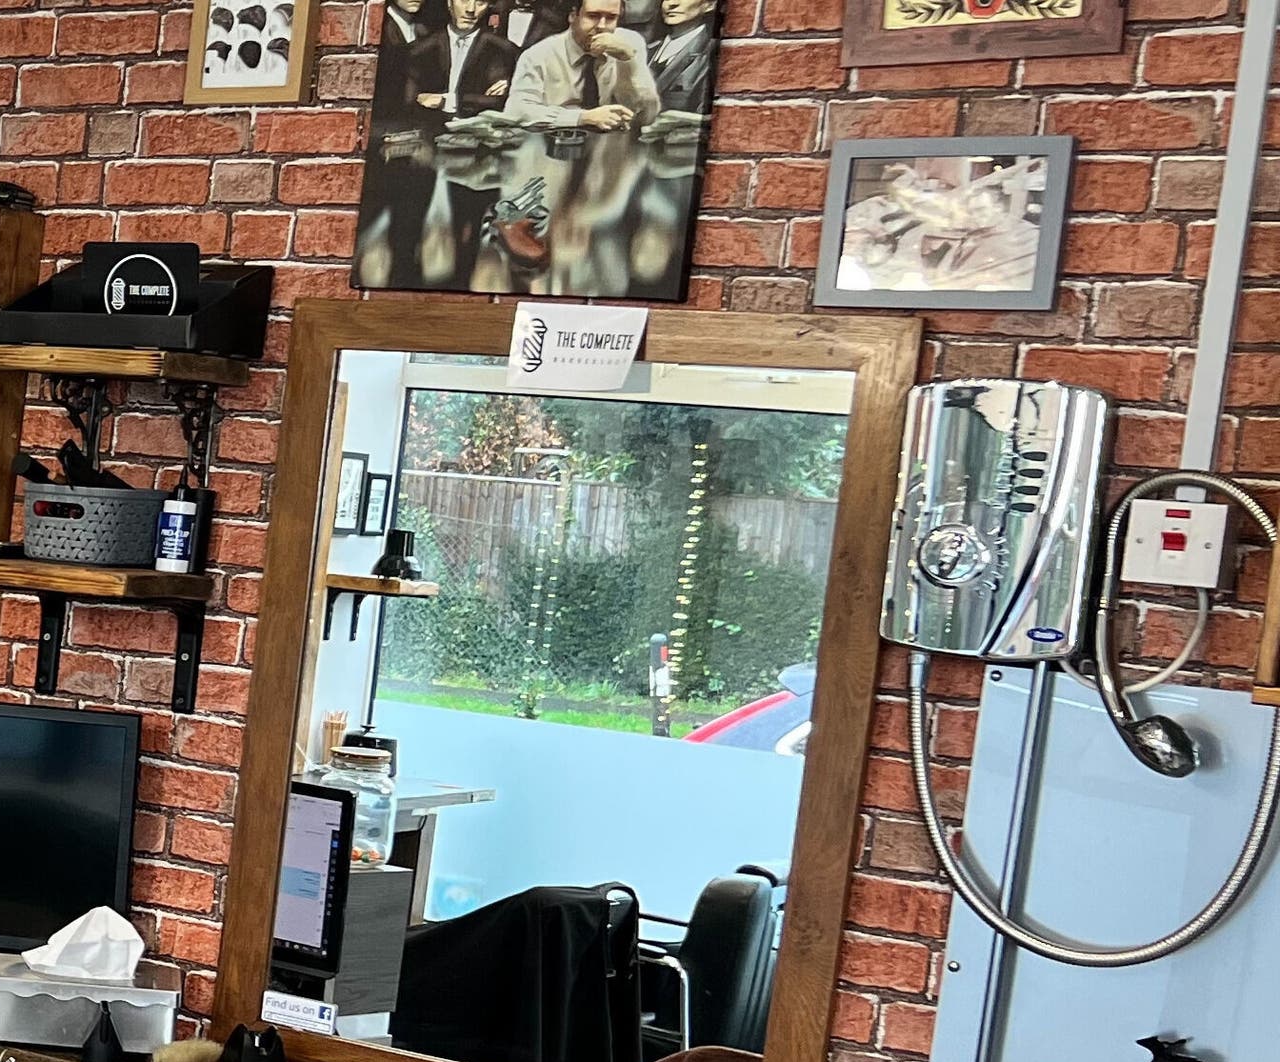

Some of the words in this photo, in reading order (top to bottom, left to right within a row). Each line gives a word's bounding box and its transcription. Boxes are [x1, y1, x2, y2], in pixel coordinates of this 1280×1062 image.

[141, 285, 170, 296] COMPLETE
[556, 331, 577, 349] THE
[579, 332, 635, 351] COMPLETE
[265, 996, 288, 1010] Find
[288, 1004, 300, 1013] us
[302, 1006, 315, 1015] on
